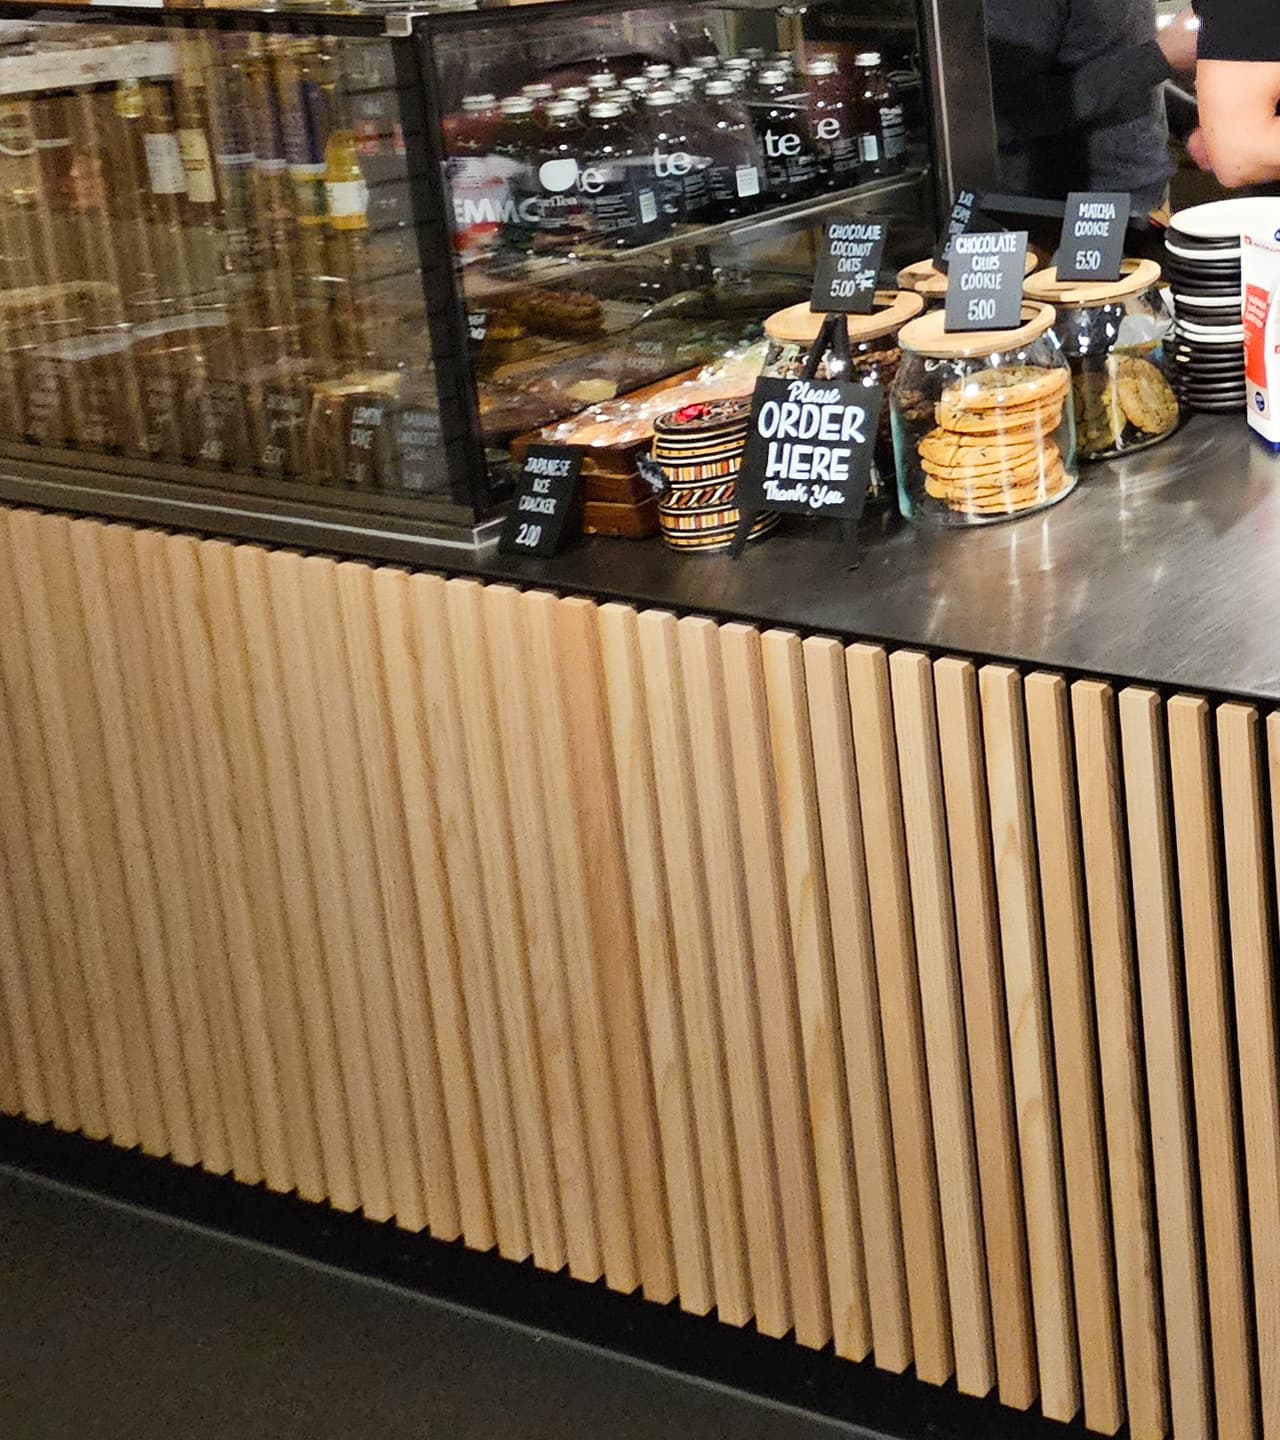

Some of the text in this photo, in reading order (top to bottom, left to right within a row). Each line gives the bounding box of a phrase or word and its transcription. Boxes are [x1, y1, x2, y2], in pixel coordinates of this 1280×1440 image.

[1079, 202, 1116, 220] MATCHA
[829, 223, 882, 241] CHOCOLATE
[1074, 220, 1110, 237] COOKIE
[830, 240, 874, 257] COCONUT
[955, 234, 1017, 254] CHOCOLATE
[837, 257, 862, 273] OATS
[960, 272, 1004, 291] COOKIE
[787, 380, 841, 404] Please
[757, 400, 866, 443] ORDER
[524, 457, 572, 477] JAPANESE
[765, 441, 851, 481] HERE
[762, 479, 846, 509] Thank You
[518, 495, 557, 516] CRACKER
